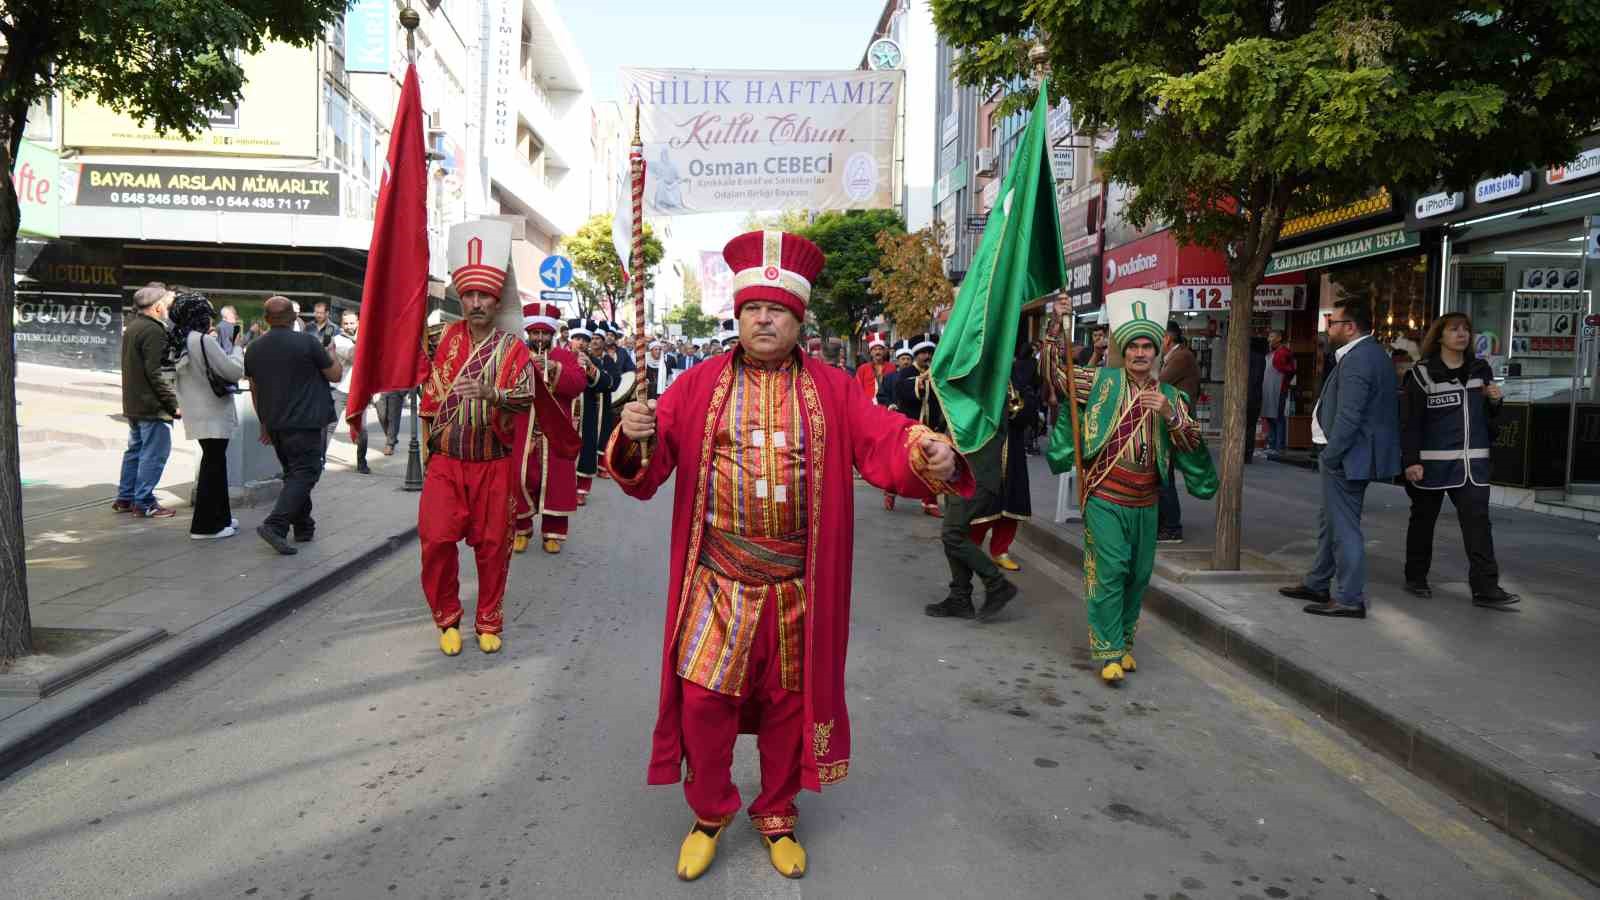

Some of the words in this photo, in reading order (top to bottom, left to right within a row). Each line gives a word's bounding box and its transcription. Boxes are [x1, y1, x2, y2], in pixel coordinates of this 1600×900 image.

[628, 75, 731, 104] AHİLİK
[745, 79, 894, 104] HAFTAMIZ
[669, 111, 759, 150] Kutlu
[689, 159, 757, 176] Osman
[764, 153, 832, 174] CEBECİ
[90, 171, 161, 188] BAYRAM
[168, 174, 236, 191] ARSLAN
[242, 174, 328, 195] MİMARLIK
[1478, 177, 1520, 197] SAMSUNG
[111, 192, 119, 202] 0
[122, 193, 145, 203] 545
[216, 195, 224, 206] 0
[226, 196, 250, 207] 544
[278, 198, 291, 209] 71
[295, 199, 310, 210] 17
[1425, 197, 1454, 212] iPhone
[1323, 237, 1372, 260] RAMAZAN
[1376, 230, 1406, 248] USTA
[1073, 263, 1092, 288] SHOP
[1118, 254, 1157, 277] vodafone
[1196, 288, 1222, 309] 12
[18, 299, 112, 330] GÜMÜŞ
